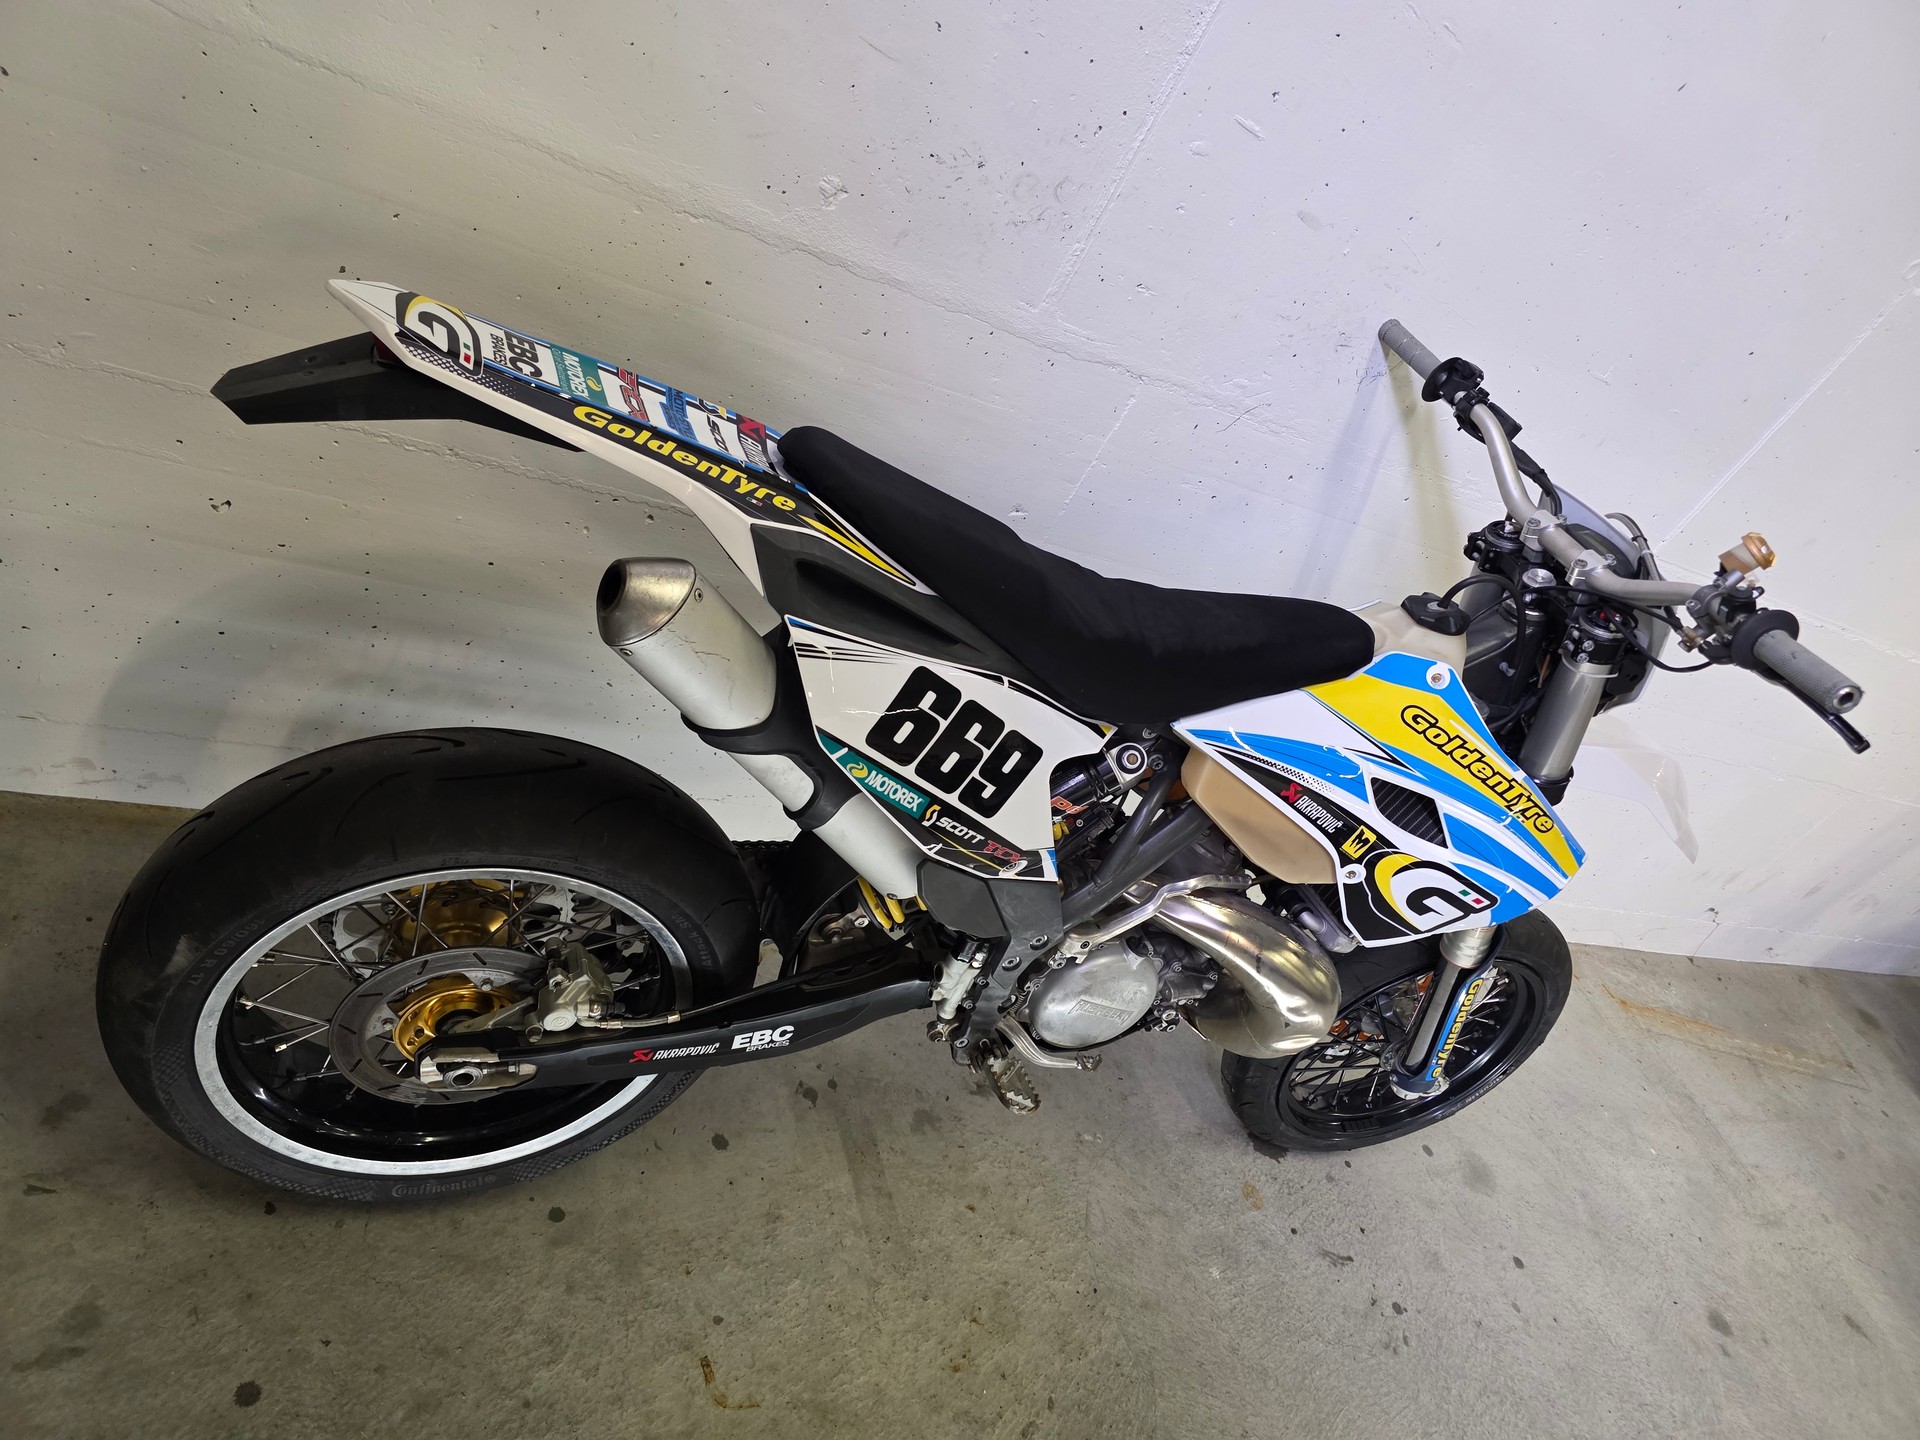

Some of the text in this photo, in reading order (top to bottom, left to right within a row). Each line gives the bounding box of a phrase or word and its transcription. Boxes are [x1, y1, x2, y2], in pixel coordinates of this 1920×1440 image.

[489, 332, 506, 368] BRAKES
[505, 331, 542, 379] EBC
[562, 351, 592, 401] MOTOREX
[573, 405, 796, 512] GoldenTyre
[865, 665, 1044, 819] 669
[864, 770, 924, 813] MOTOREX
[1400, 704, 1555, 834] GoldenTyre
[935, 816, 986, 844] SCOTT
[187, 917, 267, 985] 160/60 R 17
[731, 1025, 795, 1050] EBC
[746, 1040, 790, 1052] BRAKES
[391, 1175, 486, 1198] Continental
